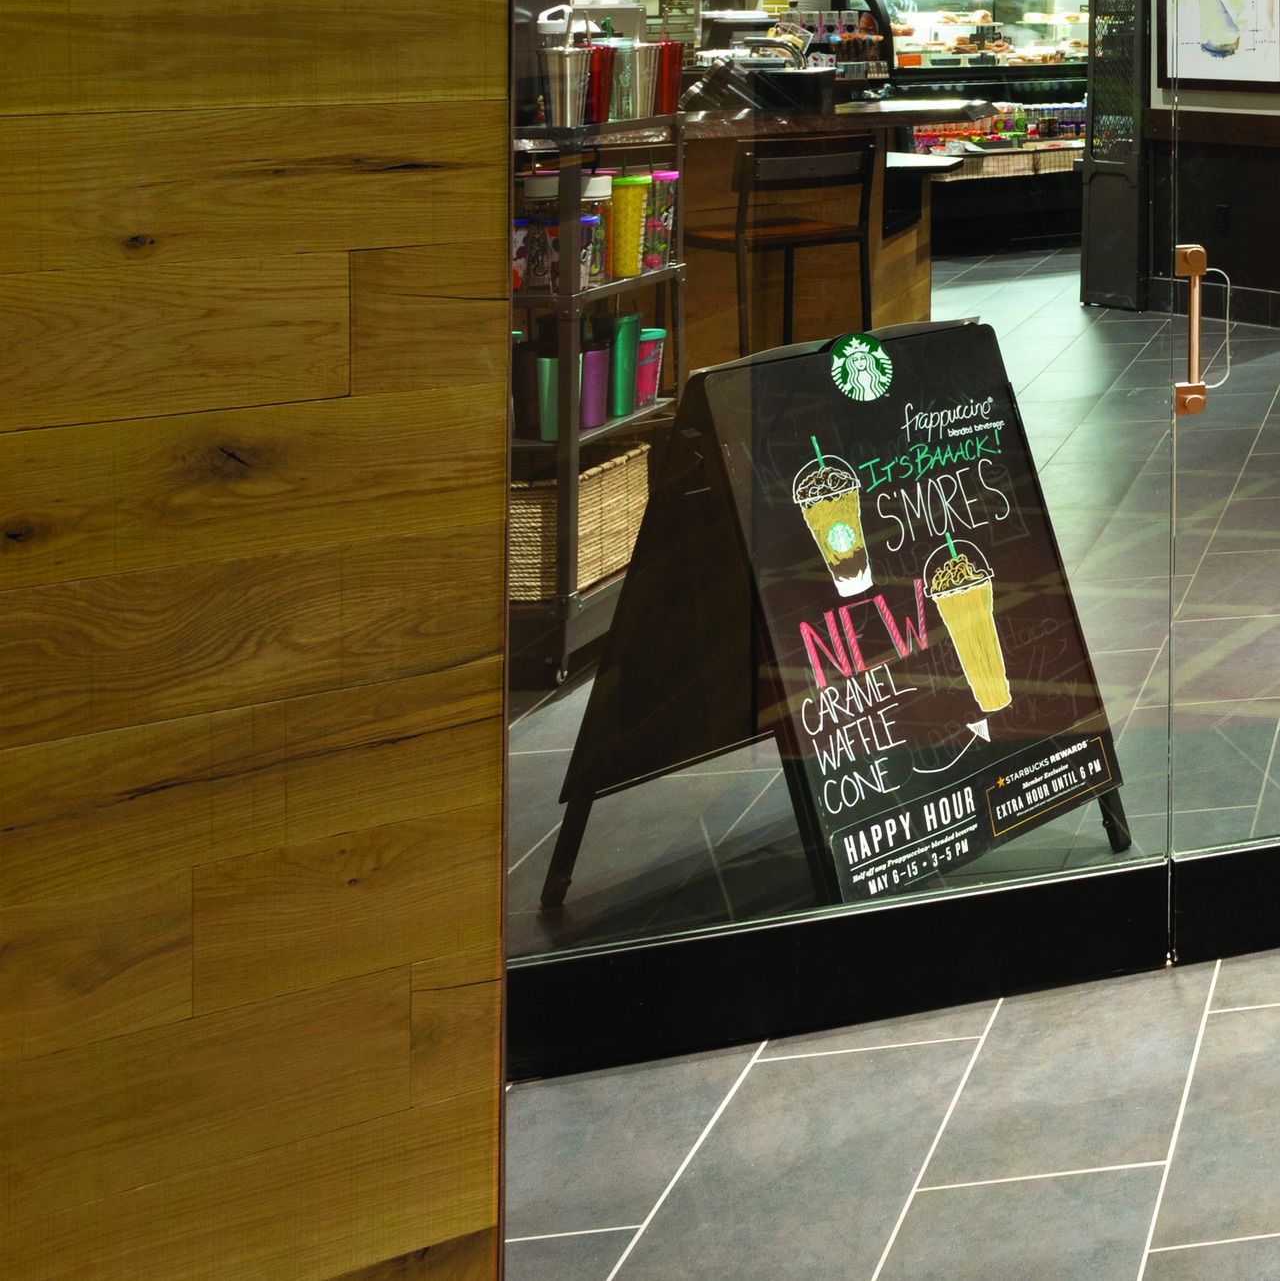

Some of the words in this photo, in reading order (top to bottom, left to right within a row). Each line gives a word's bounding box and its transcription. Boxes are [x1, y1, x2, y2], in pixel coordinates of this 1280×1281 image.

[909, 429, 1002, 481] BAAACK!
[948, 426, 973, 437] blended
[974, 420, 1006, 432] beverage
[877, 459, 1010, 551] S'MORES
[800, 579, 929, 689] NEW
[802, 663, 917, 736] CARAMEL
[812, 703, 906, 775] WAFFLE
[824, 757, 900, 814] CONE
[996, 796, 1024, 820] EXTRA
[1025, 783, 1050, 805] HOUR
[1051, 770, 1078, 793] UNTIL
[1079, 766, 1086, 780] 6
[1088, 758, 1102, 775] PM
[1005, 758, 1049, 784] STARBUCKS
[1022, 775, 1043, 789] Member
[1043, 764, 1069, 779] Exclusive
[843, 811, 911, 865] HAPPY
[923, 786, 976, 832] HOUR
[866, 867, 875, 877] off
[930, 833, 955, 848] blended
[955, 823, 978, 839] beverage
[868, 874, 889, 895] MAY
[955, 838, 969, 857] PM
